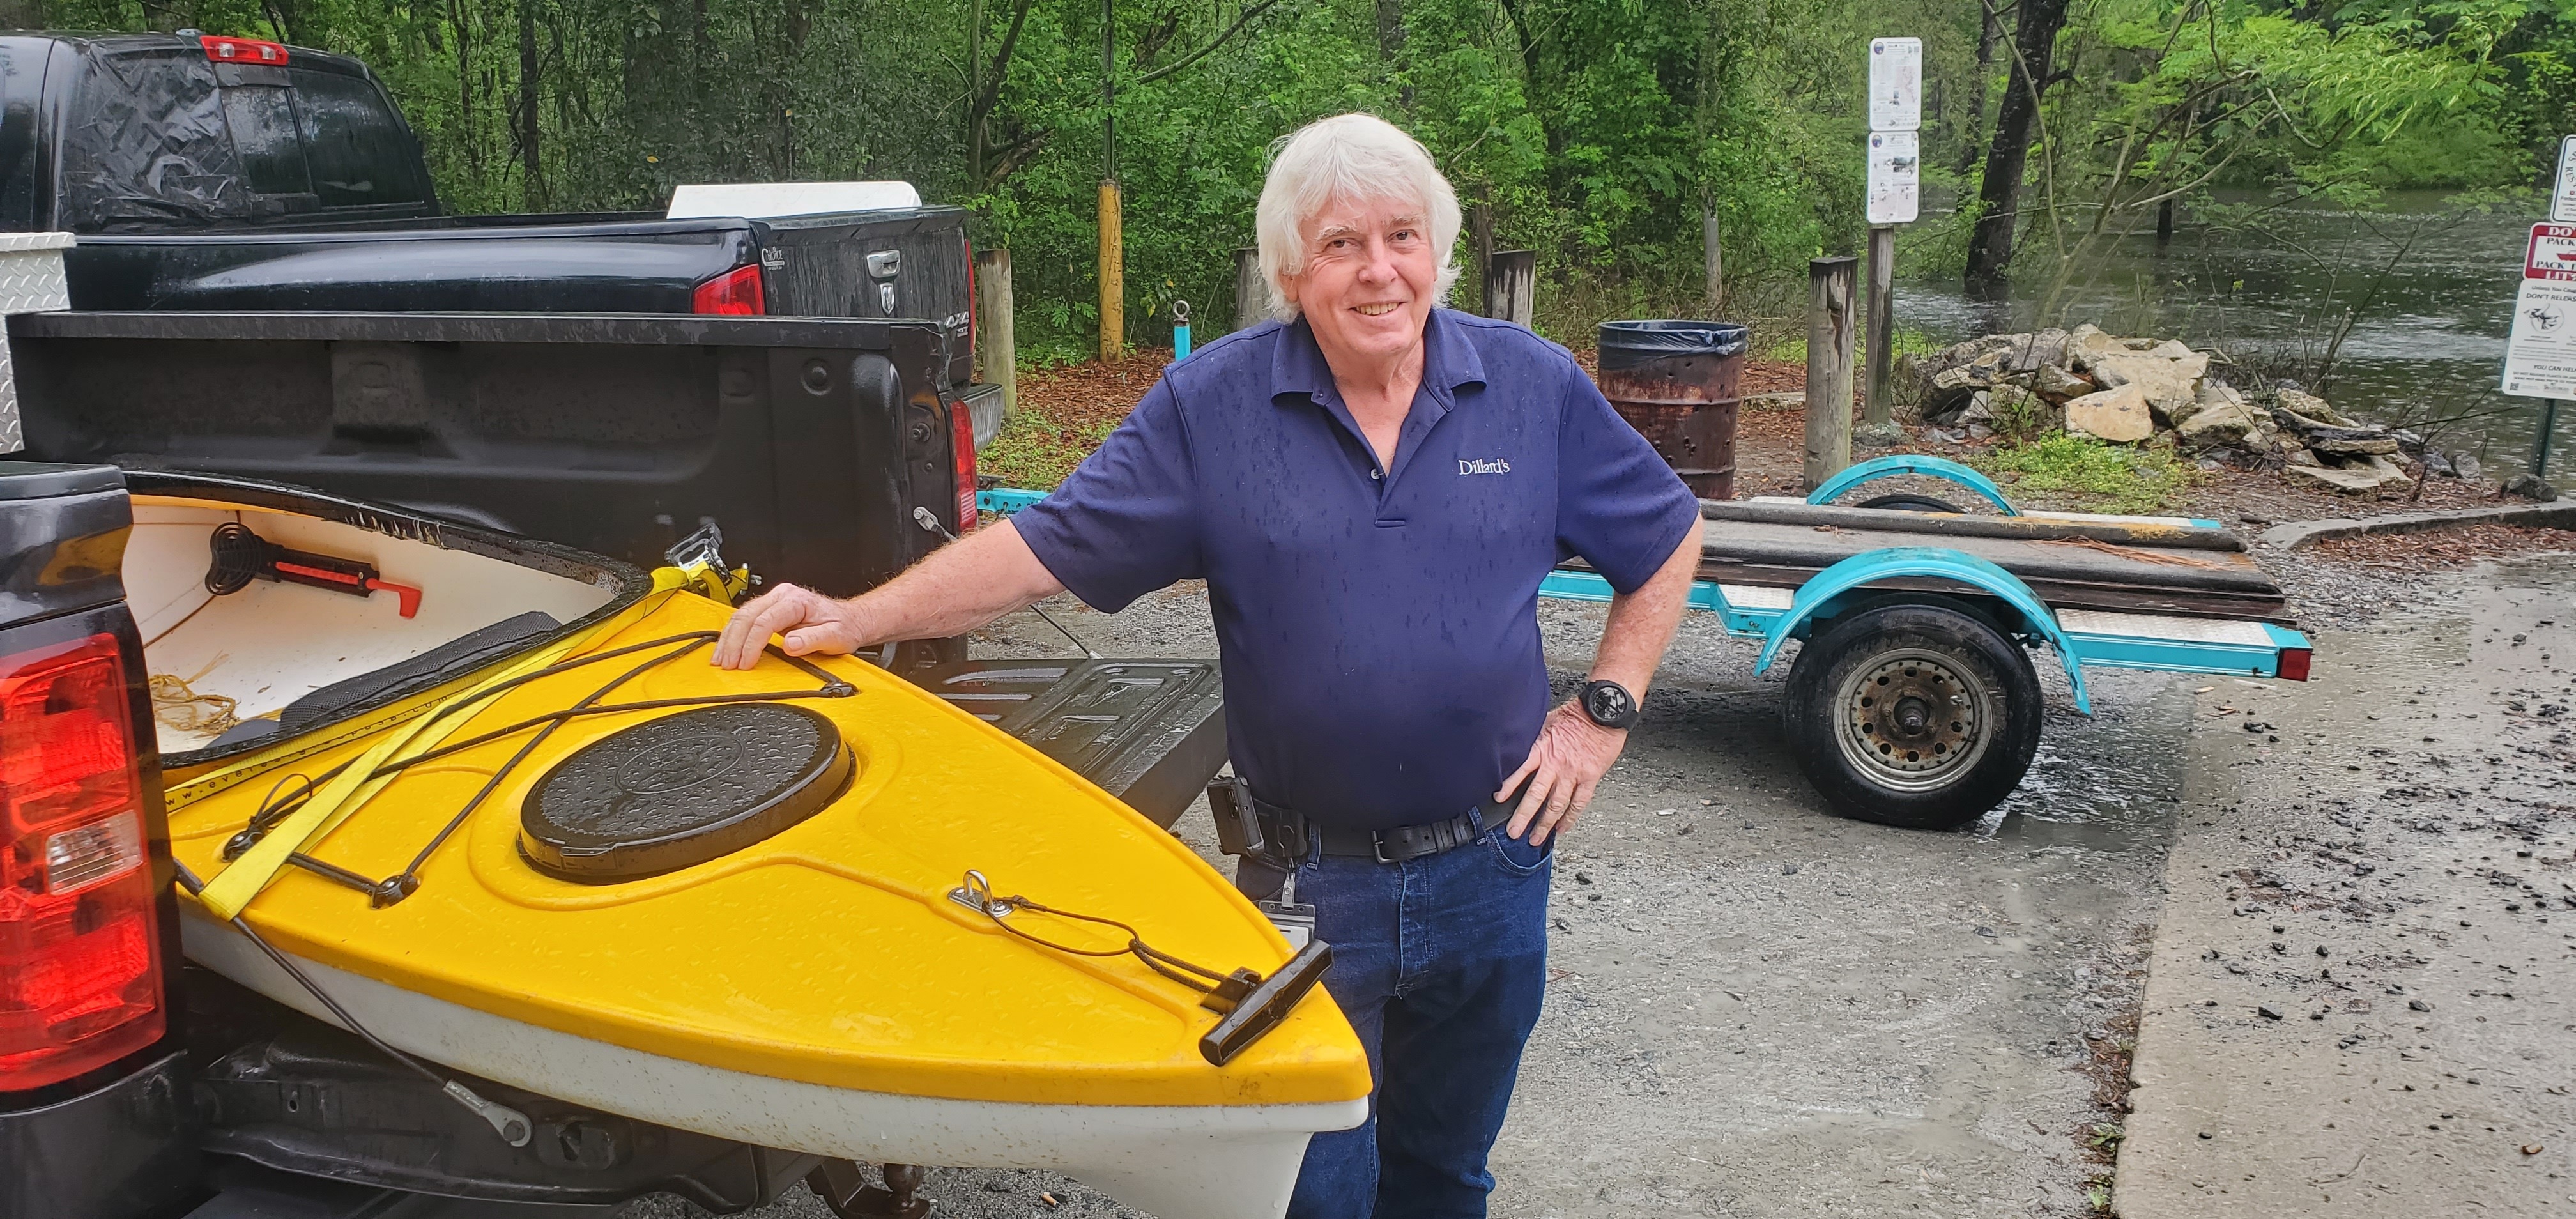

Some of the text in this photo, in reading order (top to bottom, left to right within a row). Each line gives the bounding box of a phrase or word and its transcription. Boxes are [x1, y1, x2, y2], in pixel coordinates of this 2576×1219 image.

[2547, 237, 2575, 246] PACK
[2536, 260, 2564, 270] PACK
[1458, 458, 1510, 475] Dillard's
